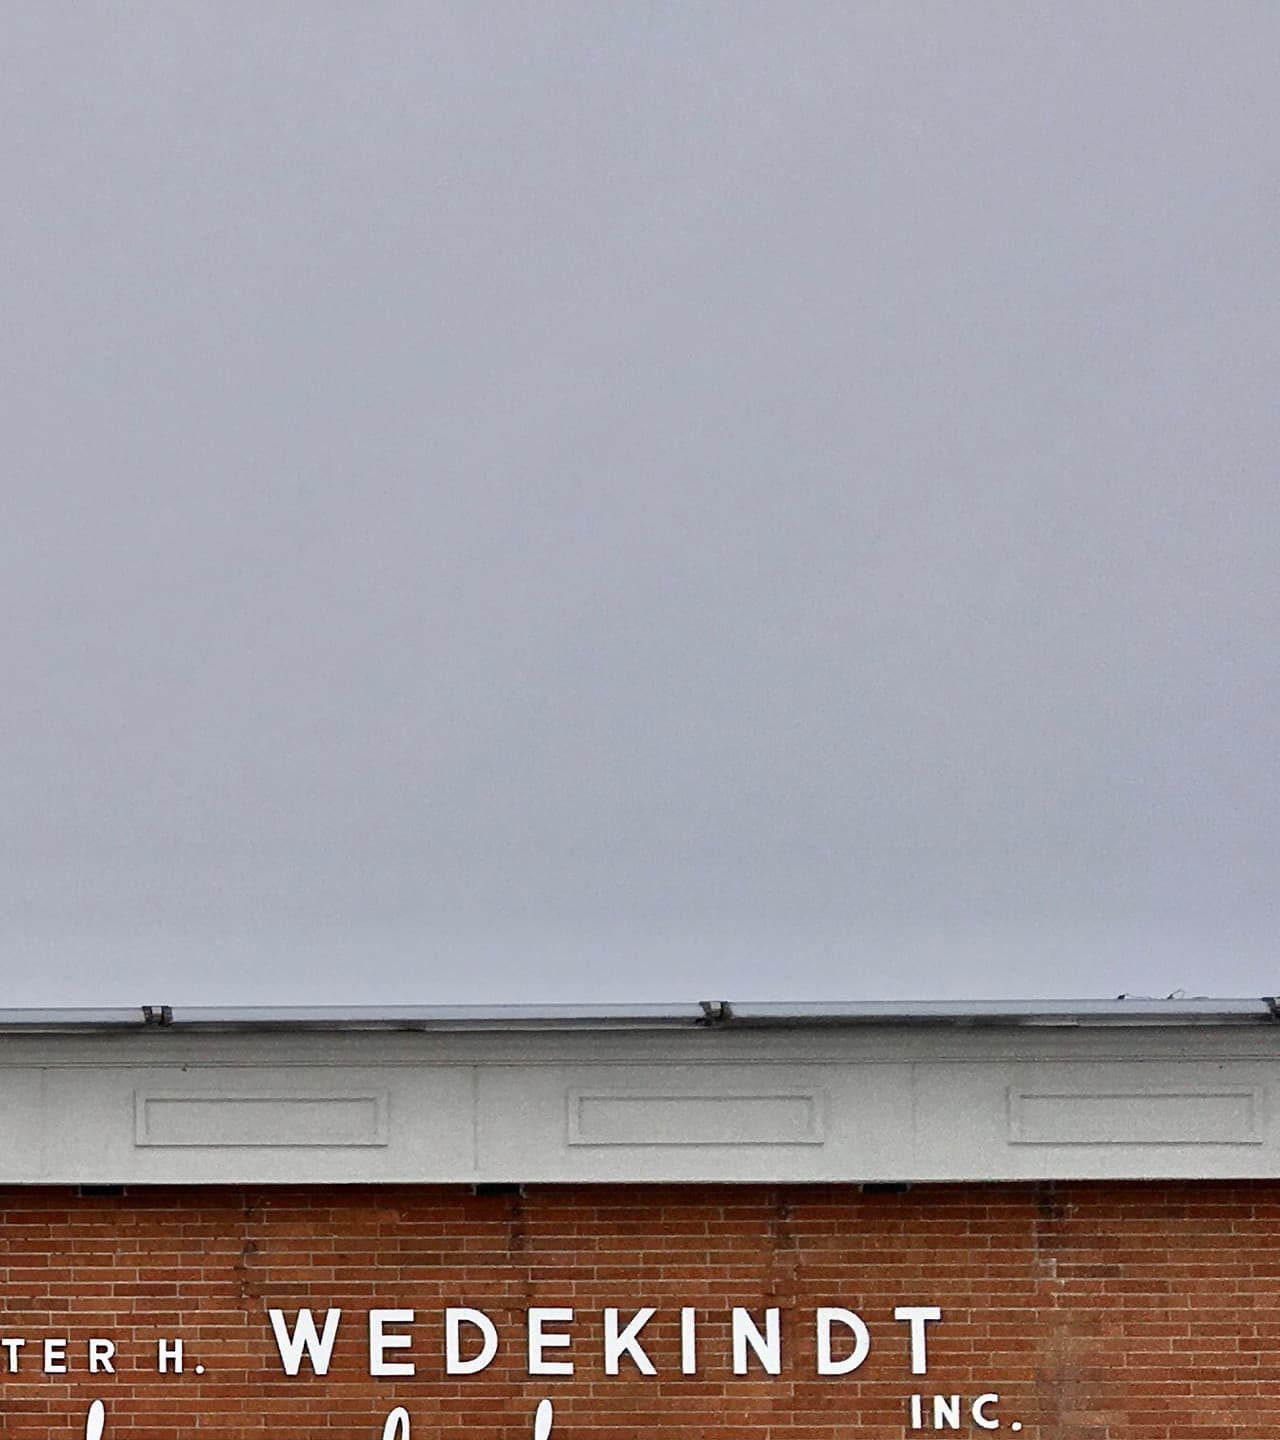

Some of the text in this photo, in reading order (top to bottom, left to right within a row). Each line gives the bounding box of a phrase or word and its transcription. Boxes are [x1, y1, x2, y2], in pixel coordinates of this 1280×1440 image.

[157, 1337, 206, 1375] H.
[267, 1305, 942, 1377] WEDEKINDT
[910, 1392, 1023, 1431] INC.
